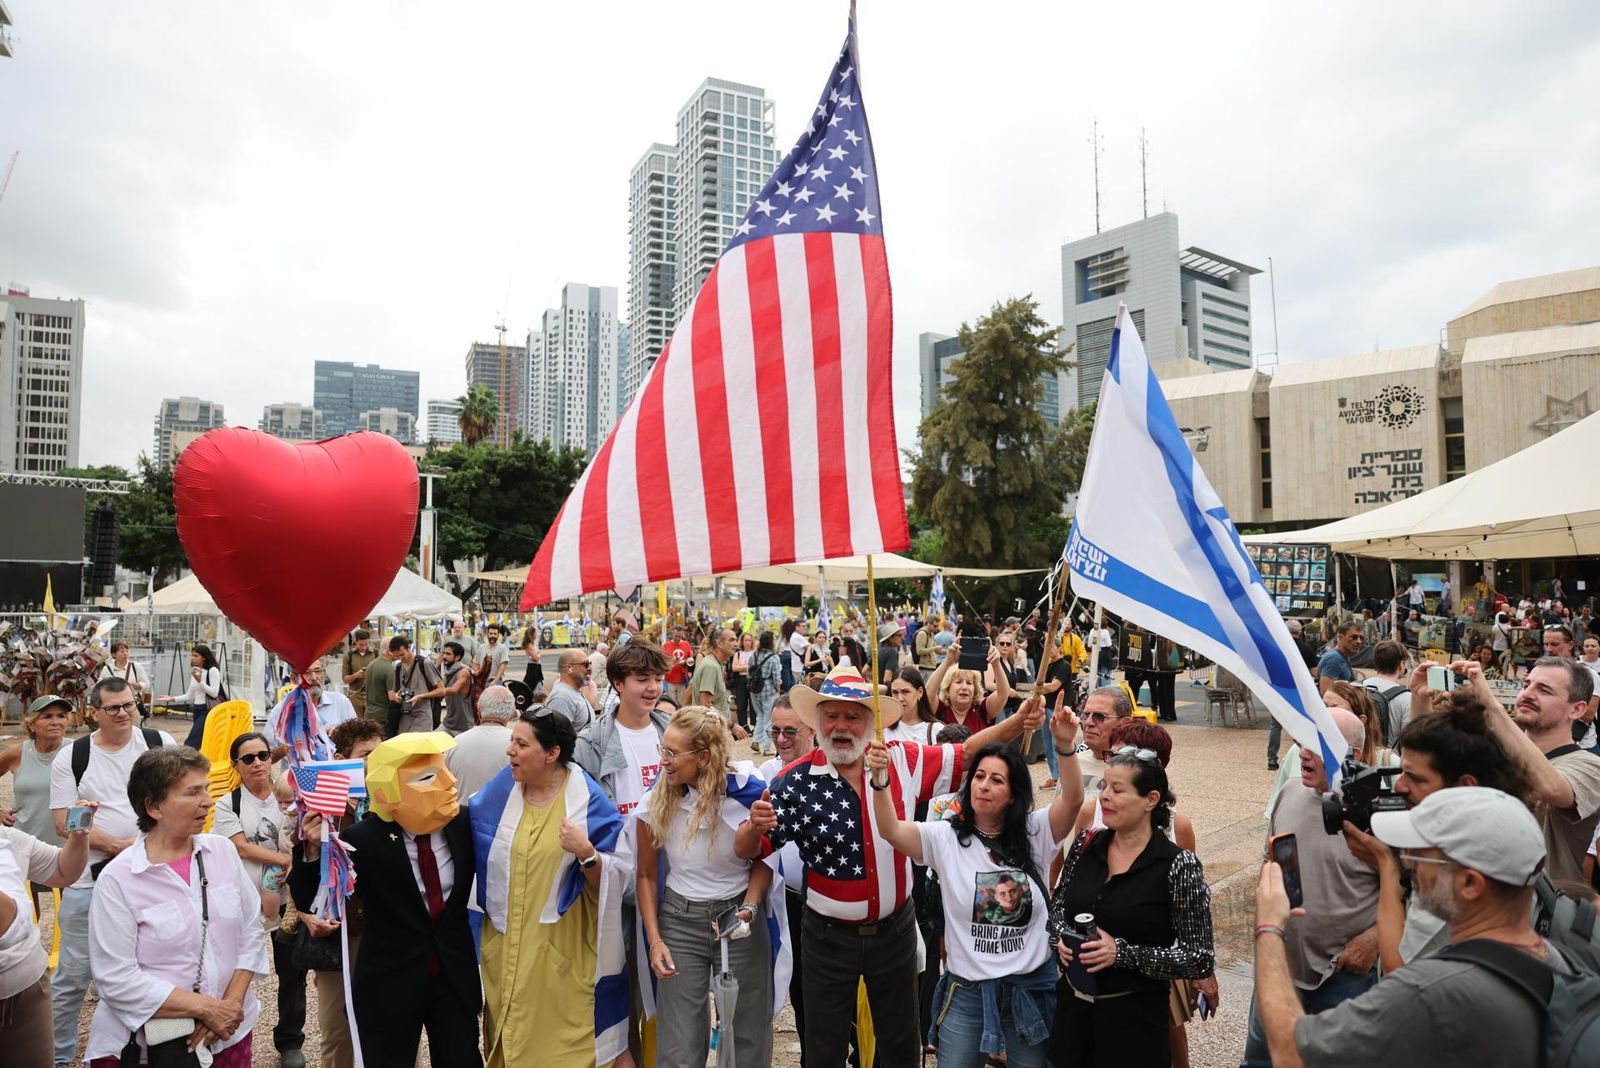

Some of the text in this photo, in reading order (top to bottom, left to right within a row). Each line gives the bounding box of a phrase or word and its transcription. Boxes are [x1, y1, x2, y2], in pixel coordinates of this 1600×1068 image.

[1364, 400, 1375, 408] תל
[1339, 410, 1356, 418] AVIV
[1356, 408, 1375, 416] אביב
[1346, 416, 1364, 424] YAFO
[1365, 415, 1375, 423] יפו
[1360, 448, 1422, 464] ספריית
[1391, 475, 1423, 488] בית
[971, 925, 999, 940] BRING
[974, 937, 1025, 954] HOME NOW!
